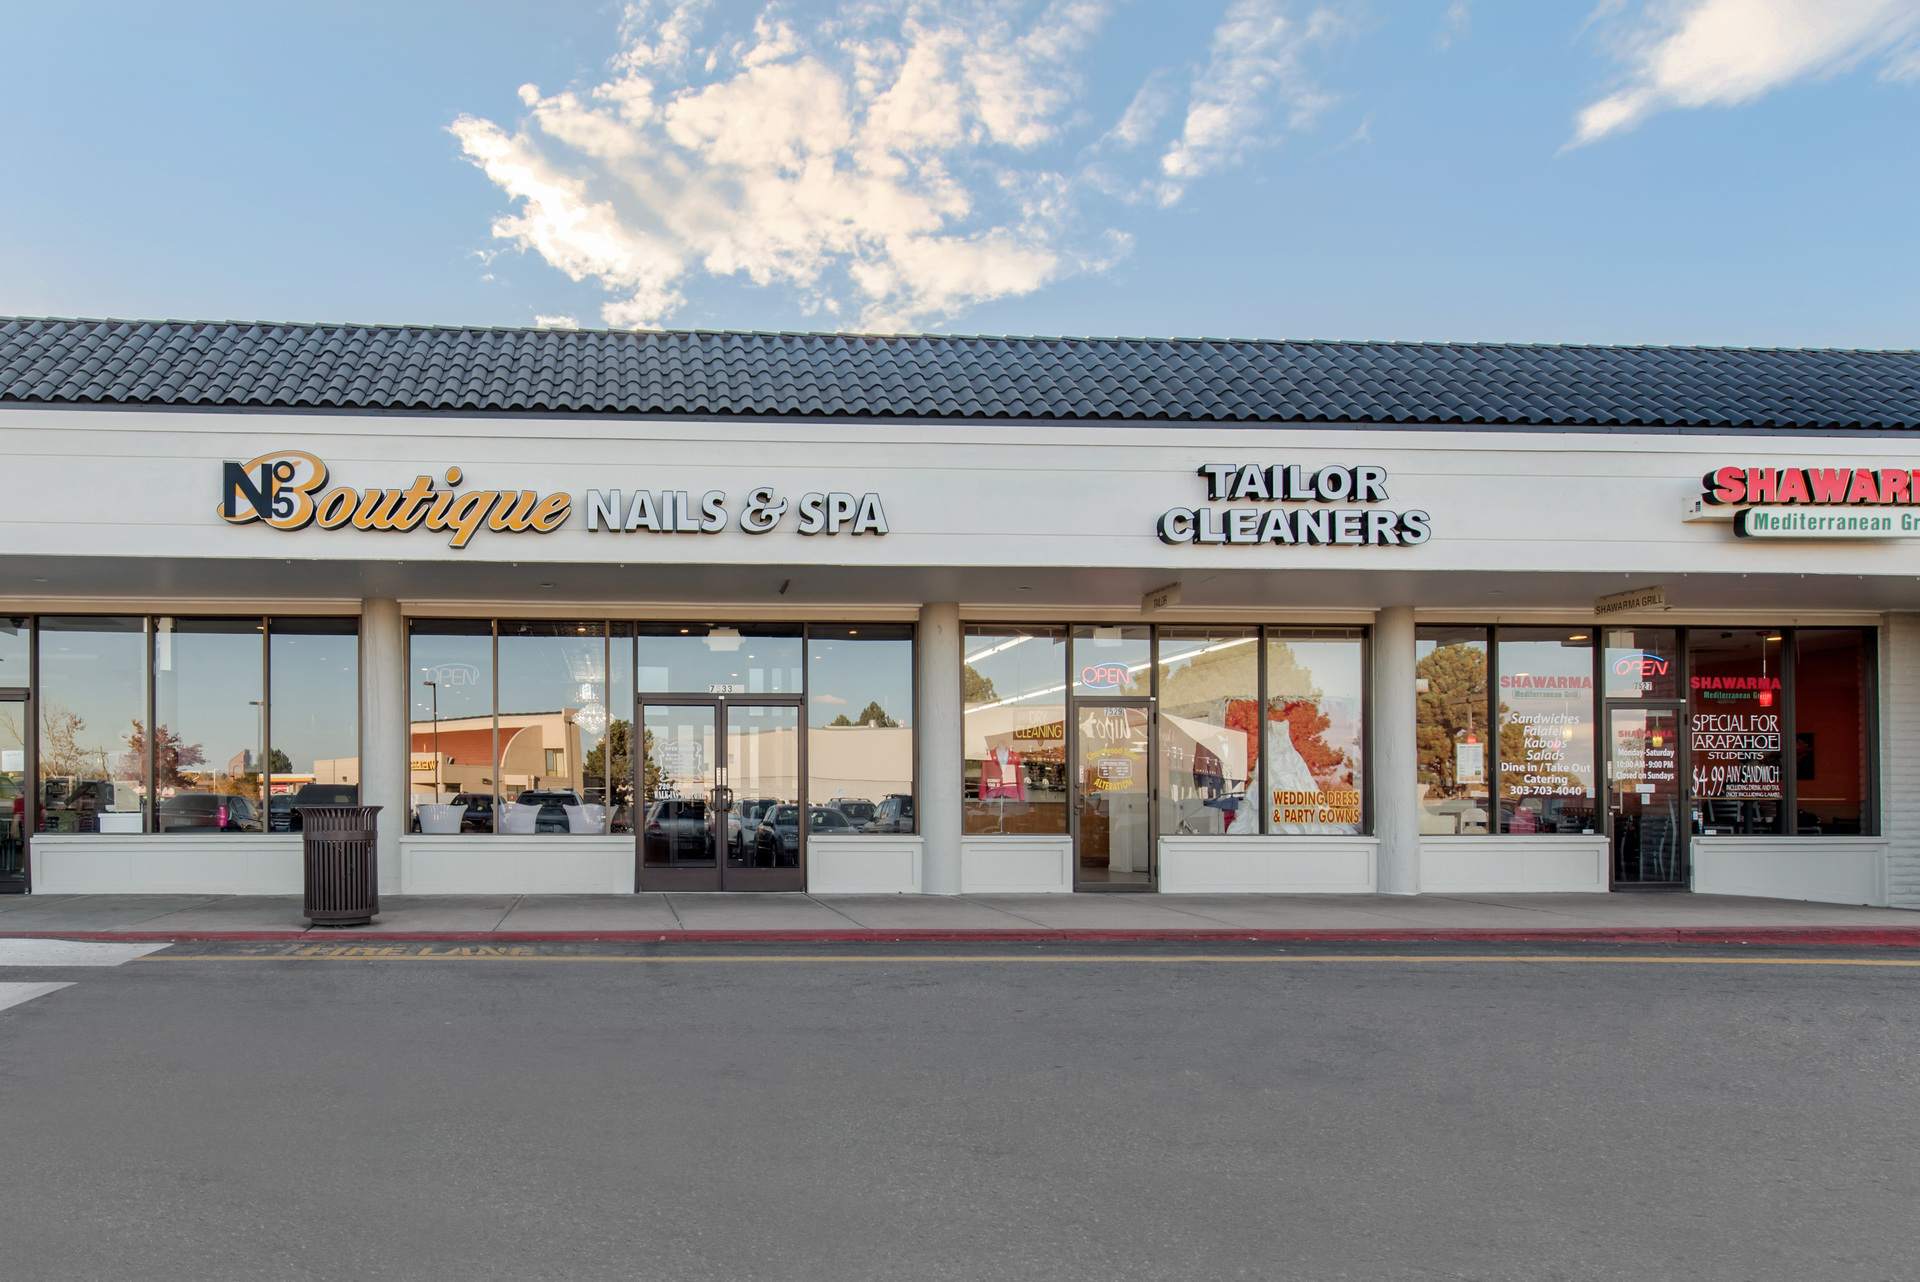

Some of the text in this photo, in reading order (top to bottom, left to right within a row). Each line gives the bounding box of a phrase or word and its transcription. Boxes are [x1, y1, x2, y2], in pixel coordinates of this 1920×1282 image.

[1197, 464, 1390, 502] TAILOR
[217, 450, 572, 549] Boutique
[586, 489, 729, 534] NAILS
[740, 486, 789, 535] &
[797, 492, 890, 536] SPA
[1156, 507, 1432, 547] CLEANERS
[1753, 513, 1892, 531] Mediterranean
[1595, 594, 1663, 616] SHAWARMA GRILL
[1615, 660, 1669, 676] OPEN
[425, 666, 477, 686] OPEN
[1082, 666, 1131, 685] OPEN
[1500, 675, 1593, 689] SHAWARMA
[1634, 682, 1652, 690] 7527
[1690, 676, 1782, 690] SHAWARMA
[1703, 691, 1751, 699] Mediterranean
[1029, 711, 1048, 725] DRY
[1105, 707, 1123, 716] 7529
[1511, 712, 1580, 725] Sandwiches
[1691, 714, 1779, 732] SPECIAL FOR
[1014, 724, 1062, 739] CLEANING
[1523, 725, 1567, 737] Falafels
[1618, 730, 1673, 738] SHAWARMA
[1523, 737, 1567, 749] Kabobs
[1693, 734, 1779, 750] ARAPAHOE
[1526, 749, 1566, 761] Salads
[1707, 752, 1765, 761] STUDENTS
[1501, 762, 1526, 773] Dine
[1527, 762, 1538, 773] in
[1545, 763, 1570, 773] Take
[1571, 763, 1592, 774] Out
[1523, 774, 1568, 786] Catering
[1616, 771, 1637, 780] Closed
[1648, 771, 1675, 781] Sundays
[1691, 765, 1780, 798] $4.99 ANY SANDWICH
[1093, 778, 1134, 791] ALTERATION
[1510, 786, 1583, 796] 303-703-4040
[1272, 790, 1360, 807] WEDDING DRESS
[1272, 808, 1360, 824] & PARTY GOWNS
[301, 946, 536, 957] FIRE LANE
